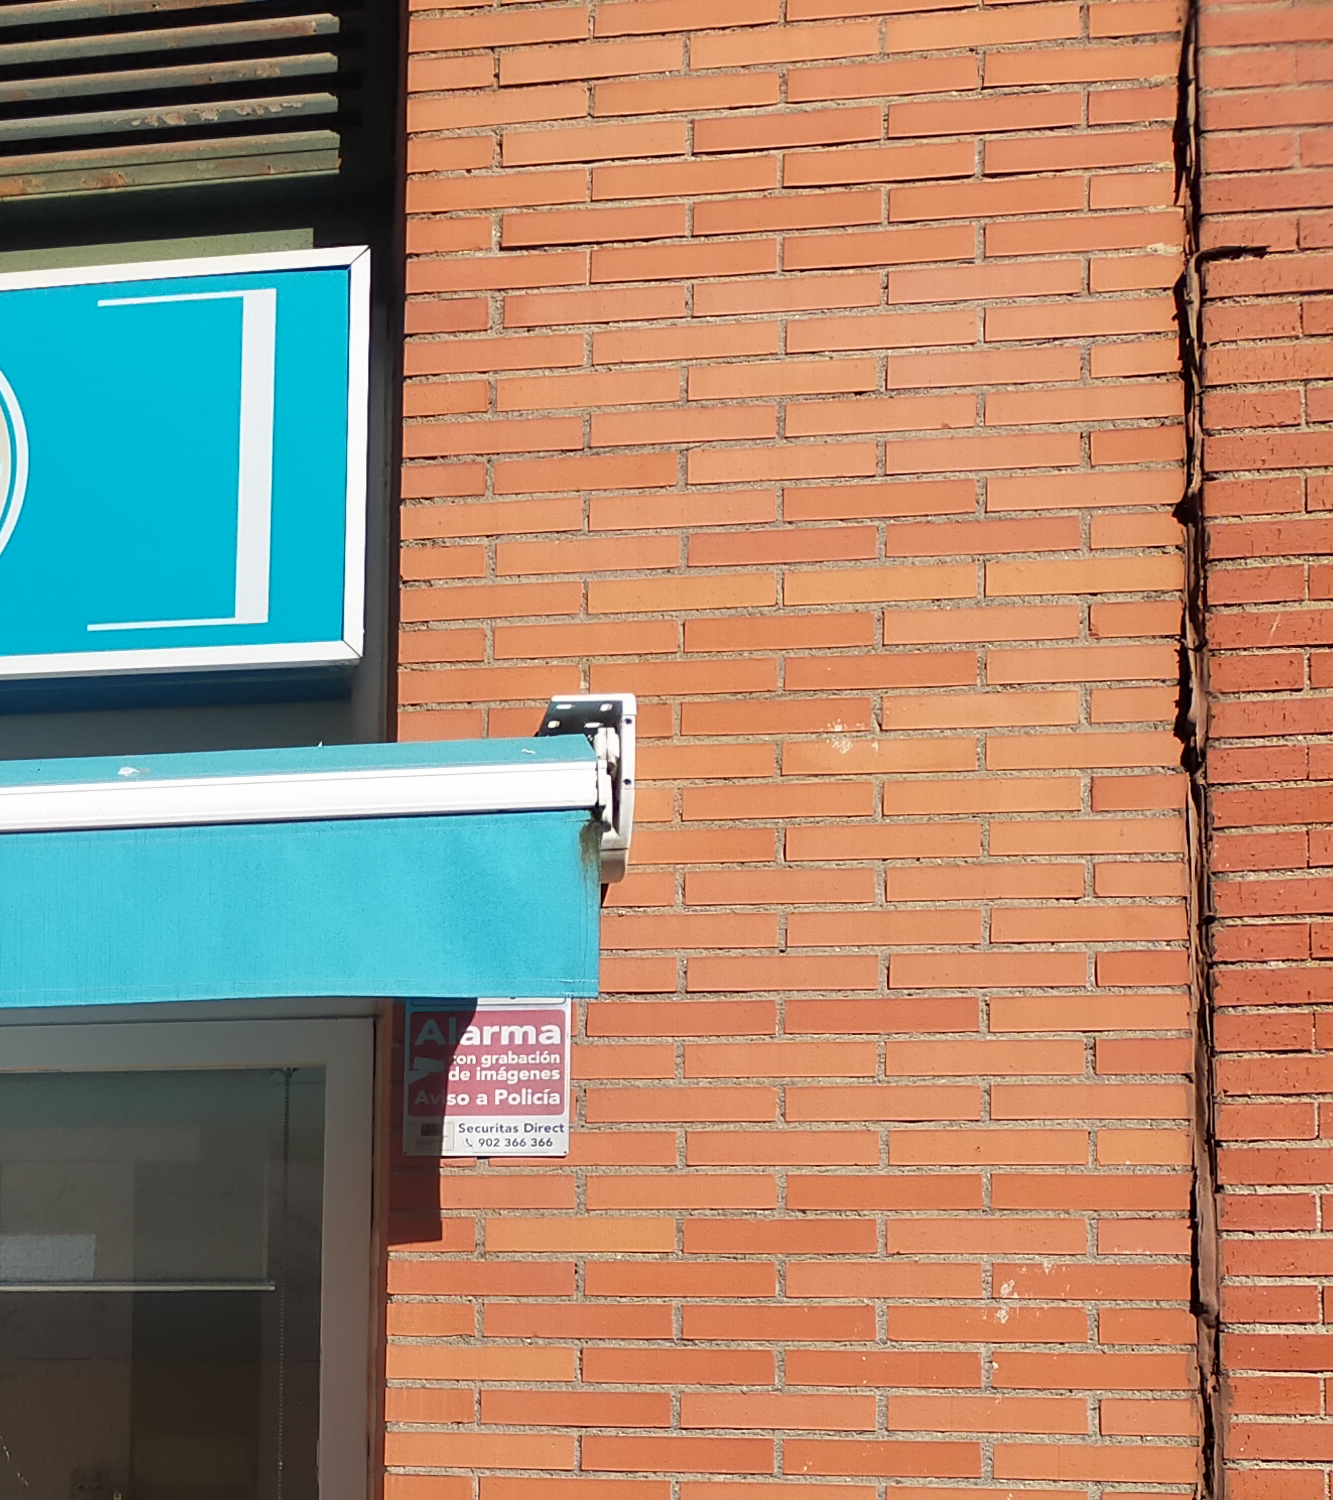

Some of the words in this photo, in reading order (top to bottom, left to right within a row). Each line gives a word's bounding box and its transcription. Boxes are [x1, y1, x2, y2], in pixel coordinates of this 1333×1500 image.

[414, 1016, 562, 1046] Alarma
[449, 1054, 477, 1065] con
[481, 1051, 561, 1067] grabación
[448, 1066, 471, 1081] de
[476, 1066, 561, 1085] imágenes
[414, 1089, 470, 1106] Aviso
[476, 1094, 488, 1105] a
[494, 1088, 561, 1106] Policía
[458, 1123, 519, 1134] Securitas
[523, 1122, 565, 1134] Direct
[478, 1138, 501, 1148] 902
[504, 1138, 527, 1148] 366
[530, 1138, 554, 1148] 366
